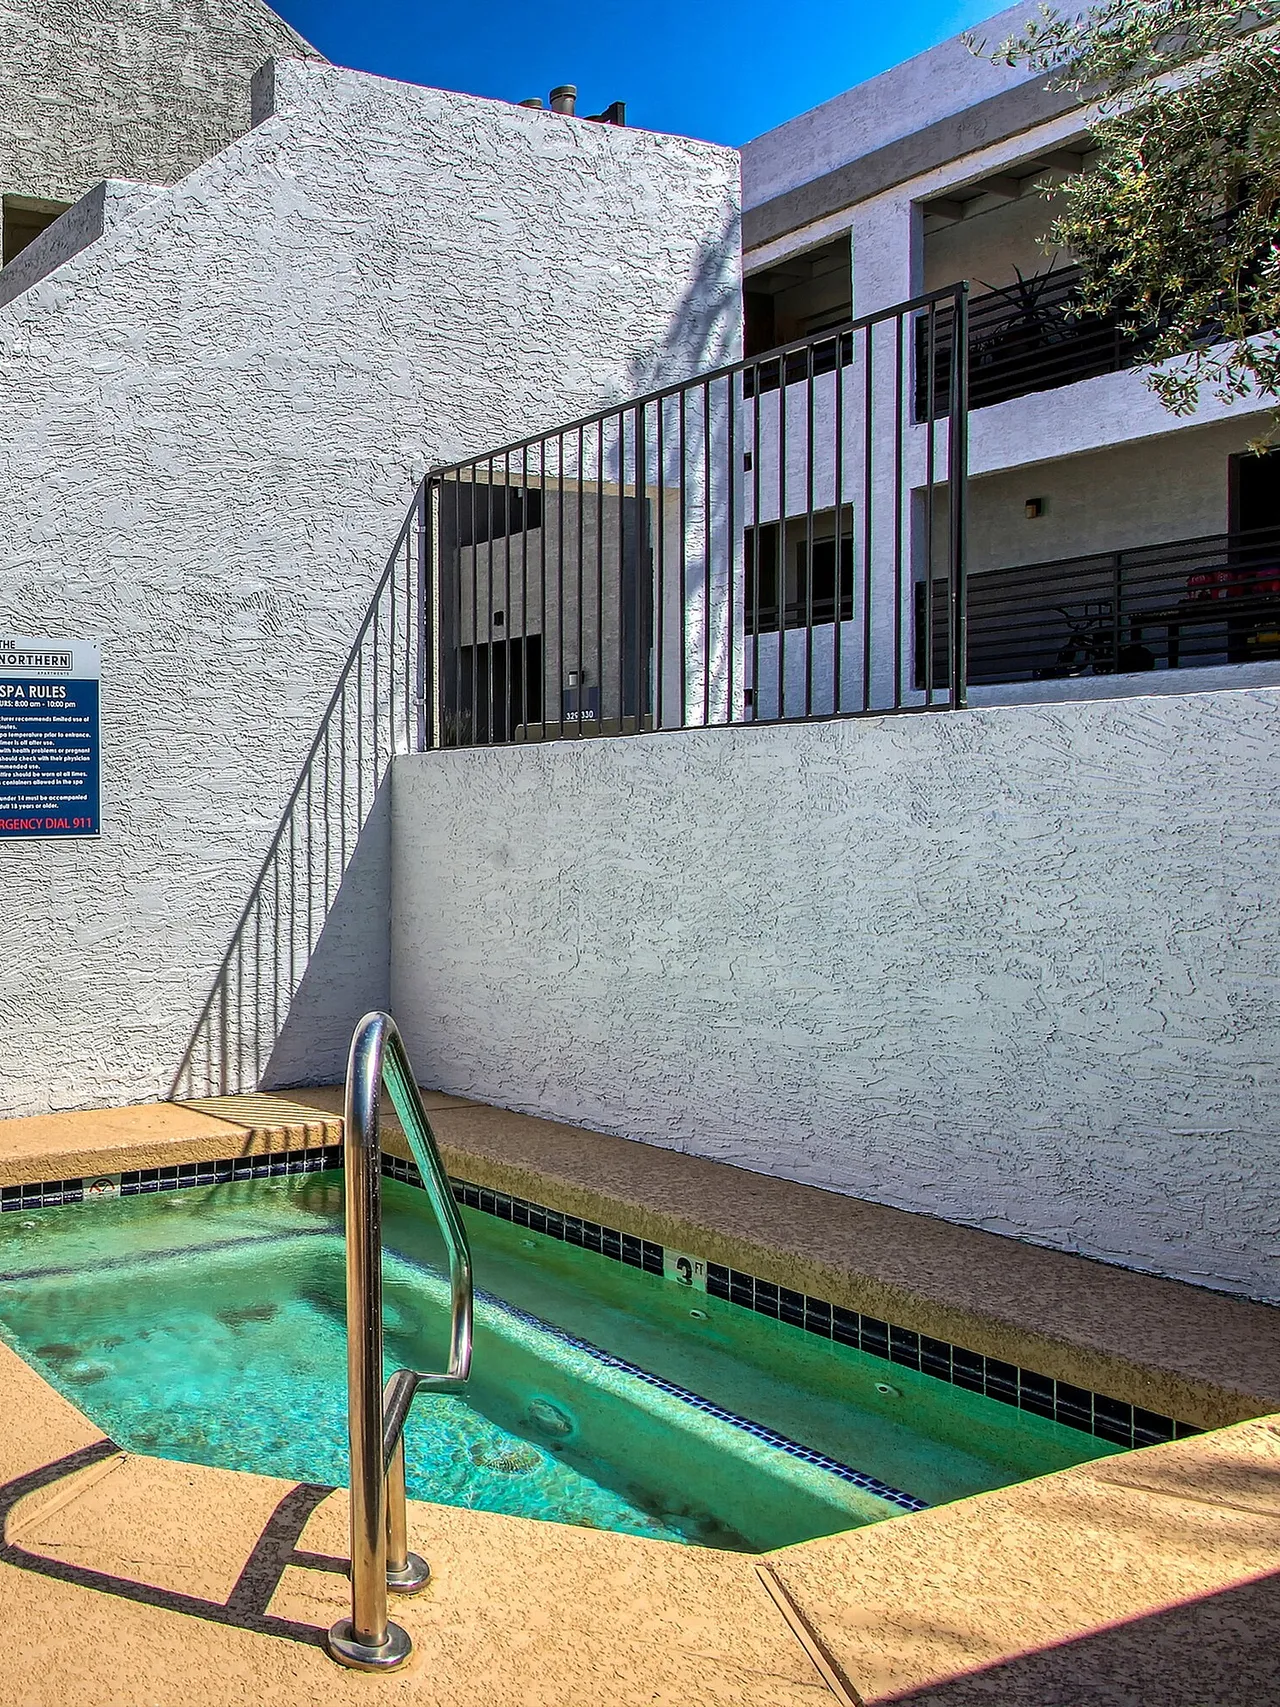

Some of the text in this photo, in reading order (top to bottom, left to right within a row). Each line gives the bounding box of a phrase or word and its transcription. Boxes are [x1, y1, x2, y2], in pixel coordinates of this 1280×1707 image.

[0, 684, 66, 698] SPA RULES
[581, 710, 594, 719] 330
[46, 818, 70, 829] DIAL
[73, 818, 92, 828] 911
[676, 1256, 704, 1286] 3 FT
